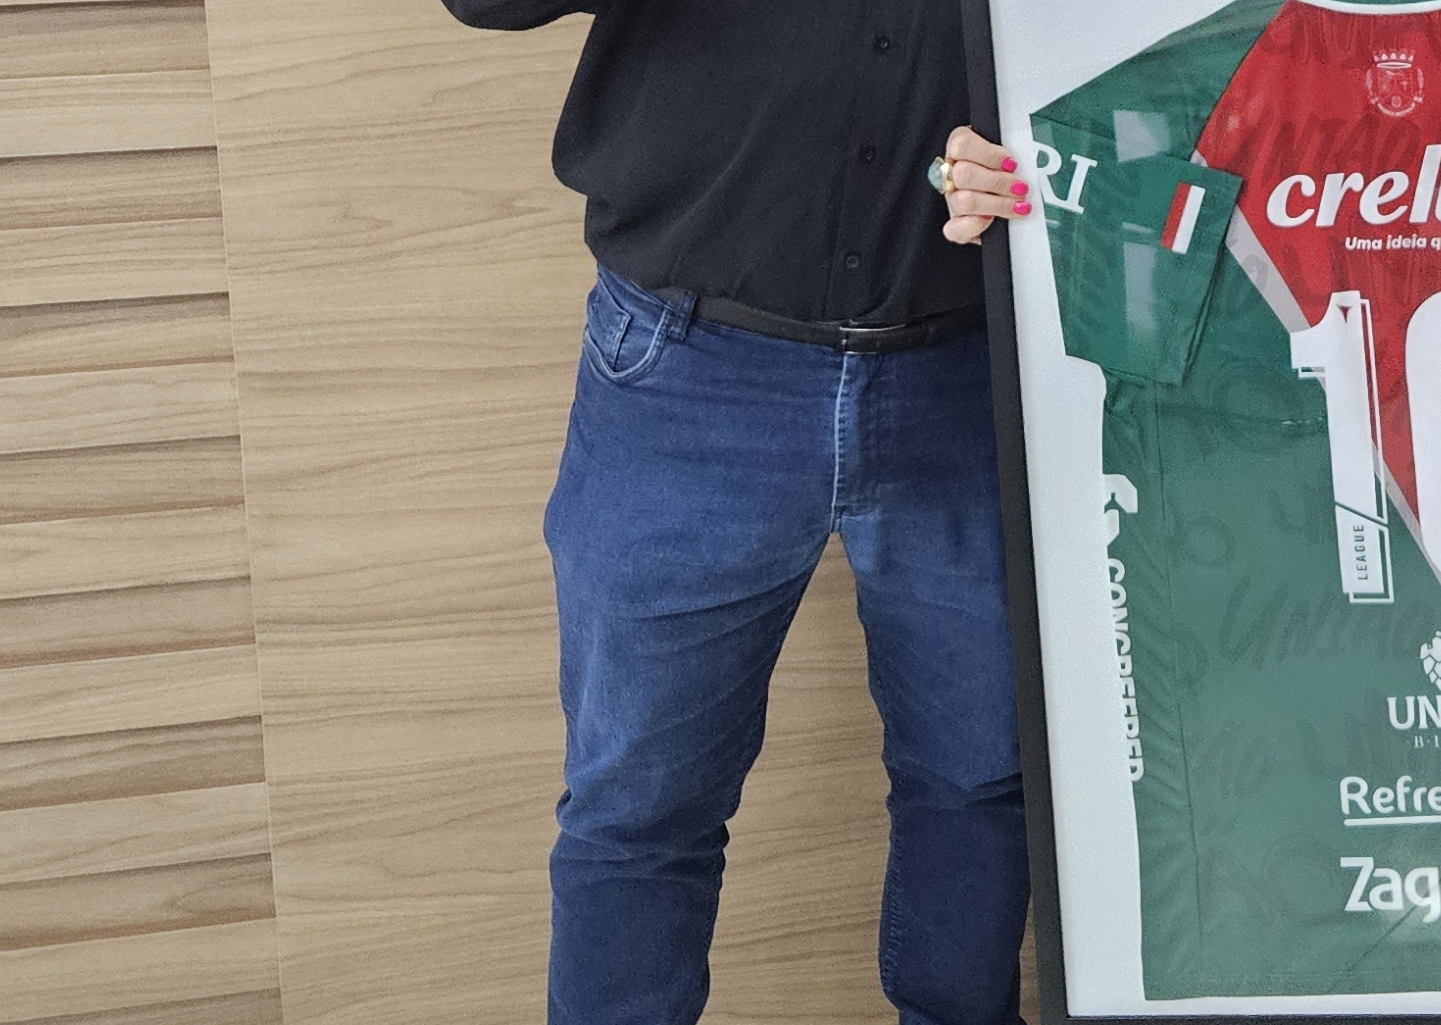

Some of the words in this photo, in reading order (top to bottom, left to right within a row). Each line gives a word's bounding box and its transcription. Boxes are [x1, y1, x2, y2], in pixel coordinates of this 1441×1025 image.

[1345, 237, 1382, 250] Uma
[1386, 234, 1427, 249] ideia
[1354, 525, 1366, 580] LEAGUE
